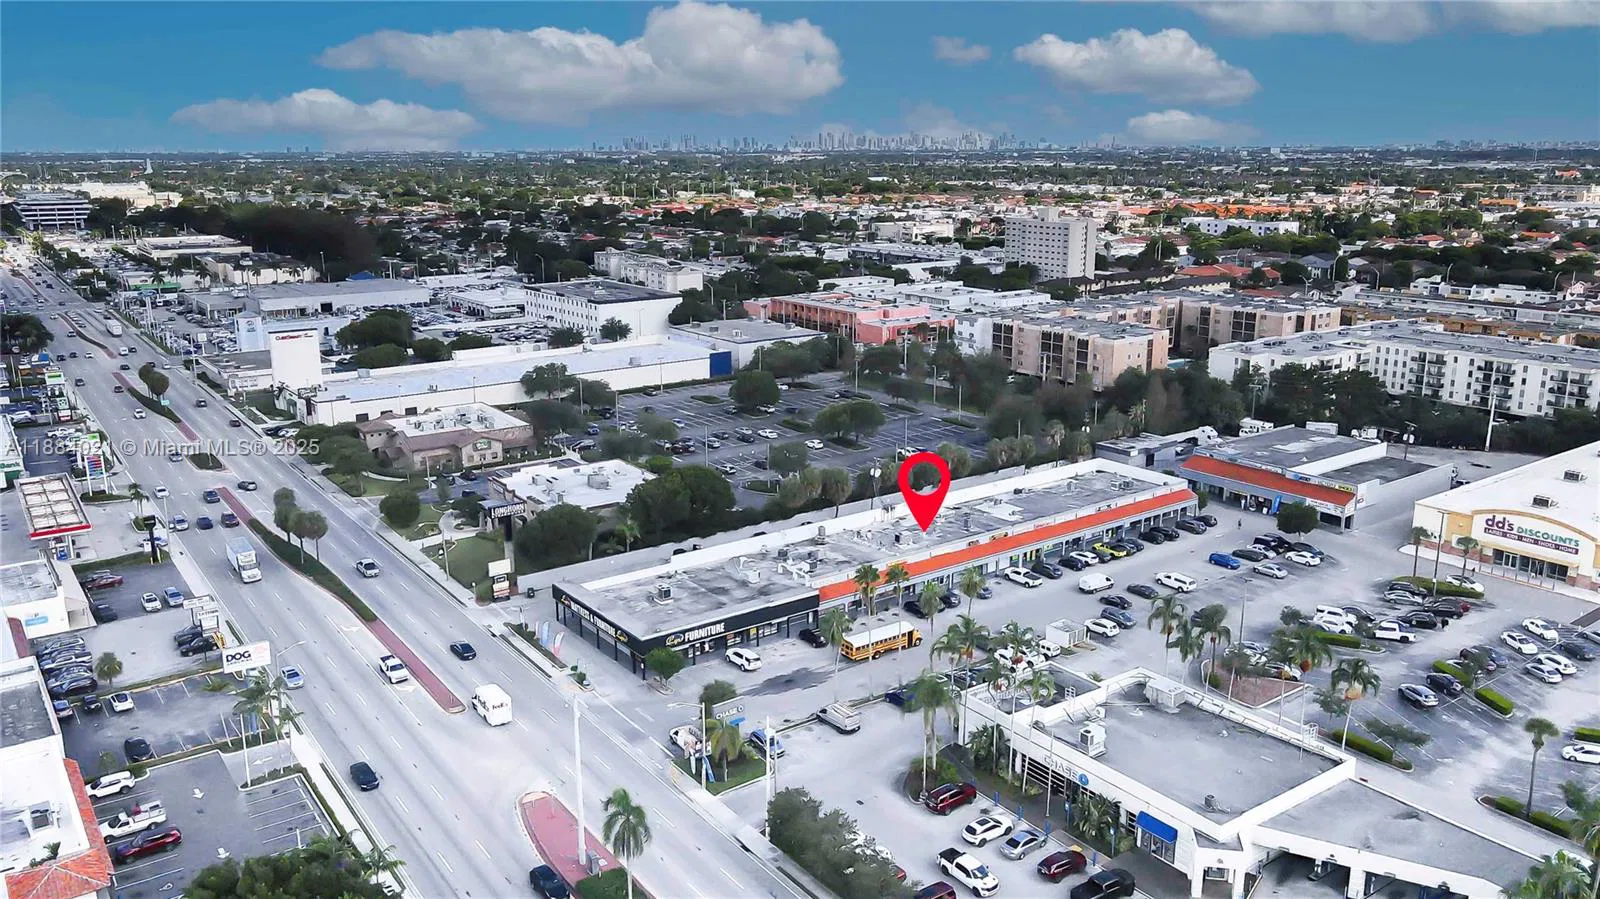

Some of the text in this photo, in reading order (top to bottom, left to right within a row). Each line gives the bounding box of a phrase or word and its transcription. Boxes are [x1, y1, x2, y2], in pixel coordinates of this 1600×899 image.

[491, 502, 527, 516] LONGHORN
[1485, 514, 1580, 547] dd's DISCOUNTS
[1522, 536, 1535, 544] MEN
[1559, 545, 1576, 554] HOME
[684, 622, 725, 642] FURNITURE
[226, 650, 251, 662] DOG
[715, 707, 738, 720] CHASE
[1042, 754, 1078, 781] CHASE
